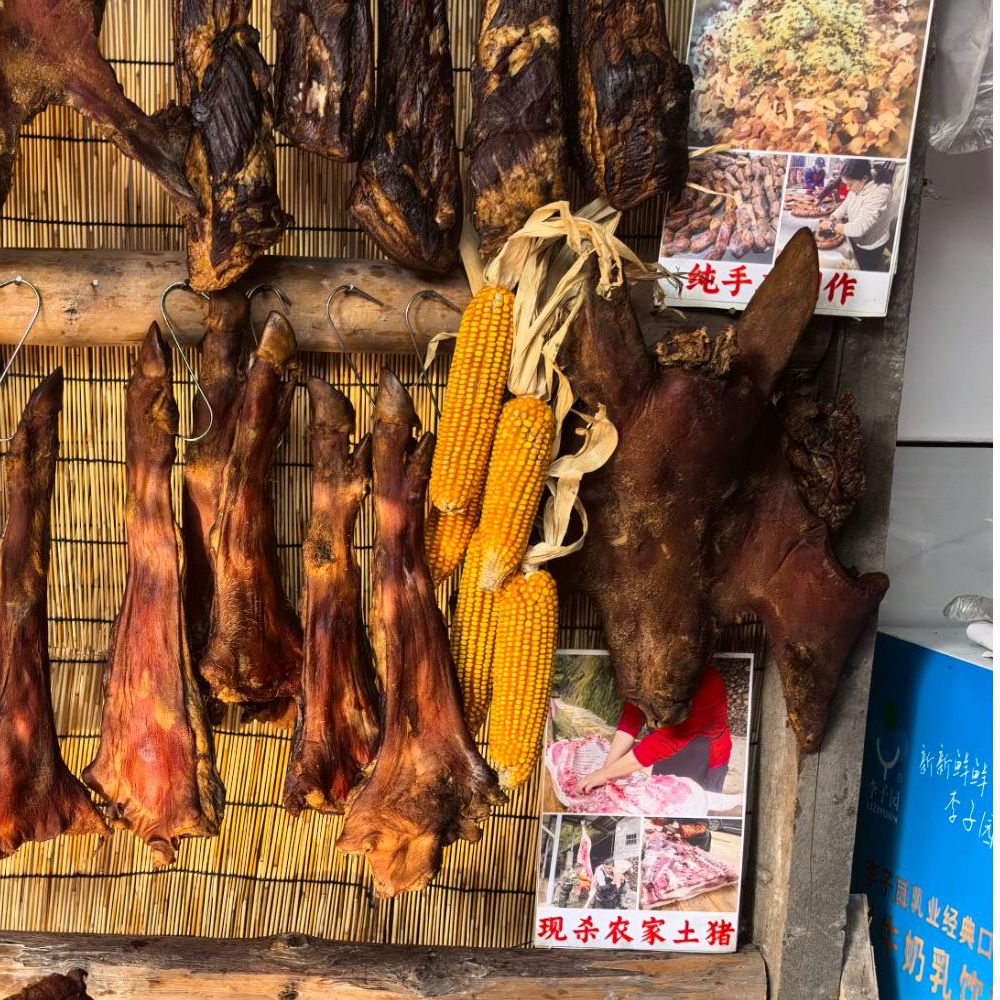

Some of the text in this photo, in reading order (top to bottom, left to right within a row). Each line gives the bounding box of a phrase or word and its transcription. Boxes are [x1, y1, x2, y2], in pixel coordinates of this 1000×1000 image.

[686, 262, 858, 305] 纯手作
[537, 915, 735, 946] 现杀农家土猪
